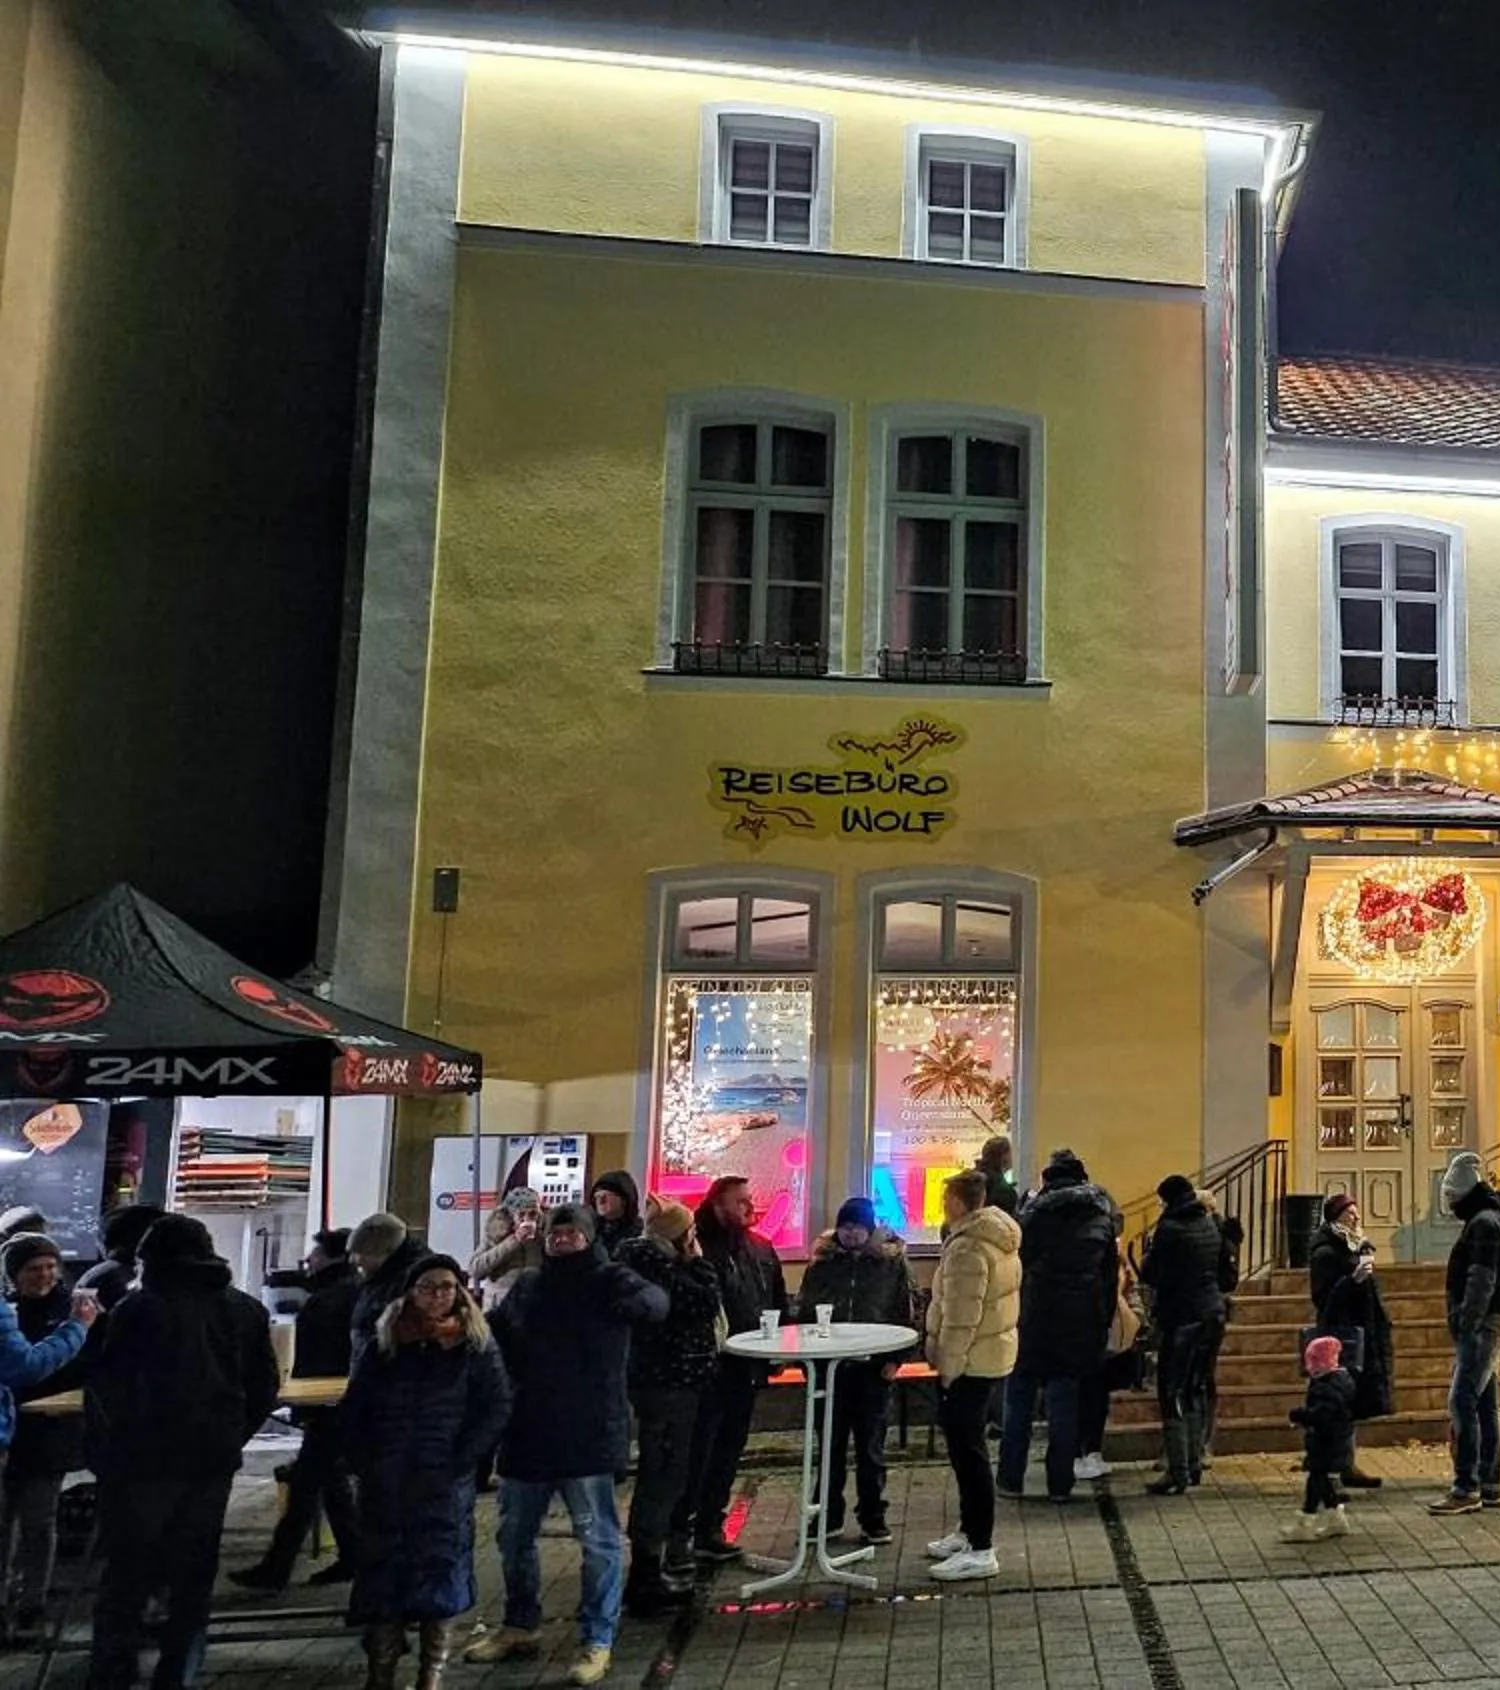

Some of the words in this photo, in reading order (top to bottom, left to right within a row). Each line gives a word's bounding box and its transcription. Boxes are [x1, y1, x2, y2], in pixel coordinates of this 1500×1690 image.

[719, 757, 948, 795] REISEBÜRO
[841, 805, 945, 834] WOLF
[85, 1057, 279, 1085] 24MX
[361, 1058, 408, 1084] 24MX
